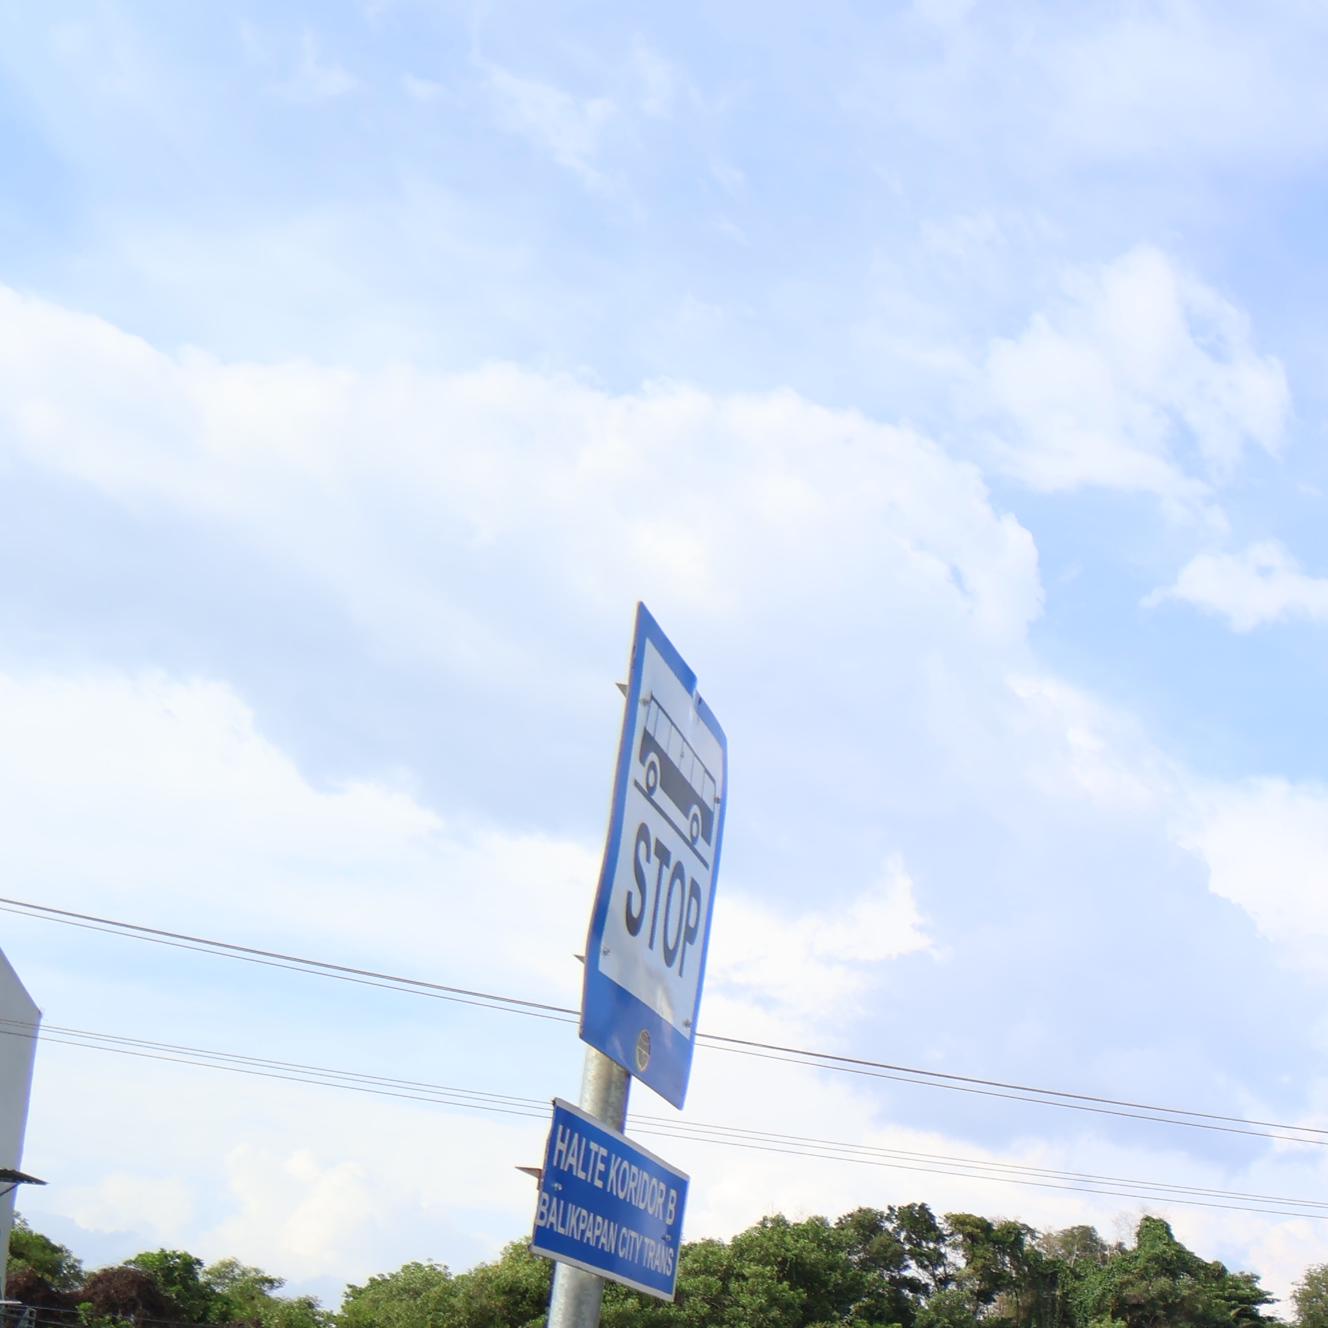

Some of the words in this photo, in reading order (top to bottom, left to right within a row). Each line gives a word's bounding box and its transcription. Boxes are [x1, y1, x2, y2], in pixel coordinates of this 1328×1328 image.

[626, 822, 702, 978] STOP
[553, 1124, 608, 1189] HALTE
[607, 1153, 667, 1220] KORIDOR
[665, 1188, 677, 1226] B
[536, 1192, 618, 1254] BALIKPAPAN
[618, 1227, 646, 1263] CITY
[643, 1237, 674, 1277] TRANS
